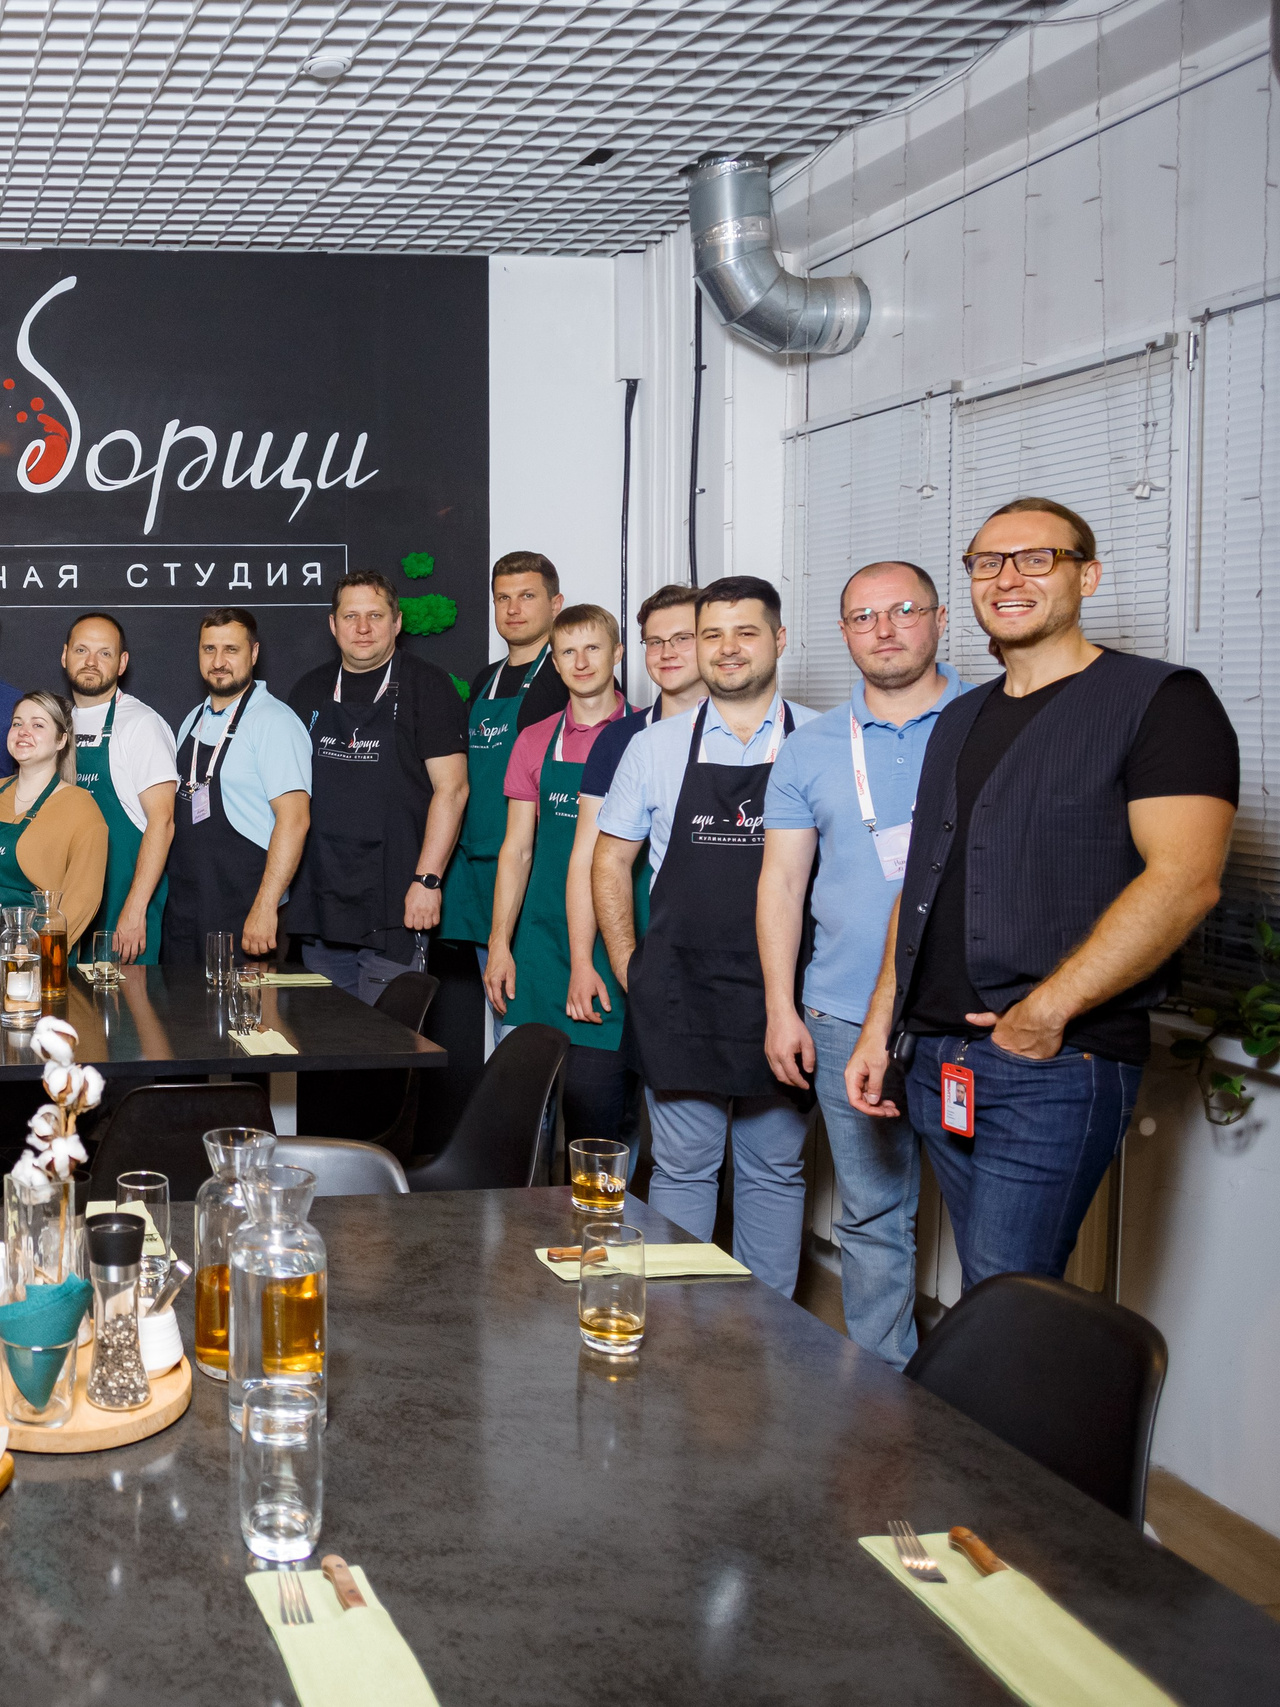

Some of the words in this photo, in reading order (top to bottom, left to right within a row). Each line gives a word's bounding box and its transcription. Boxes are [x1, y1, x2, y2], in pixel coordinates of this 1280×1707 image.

[16, 275, 380, 536] борщи
[125, 562, 323, 591] СТУДИЯ
[736, 799, 764, 834] бор
